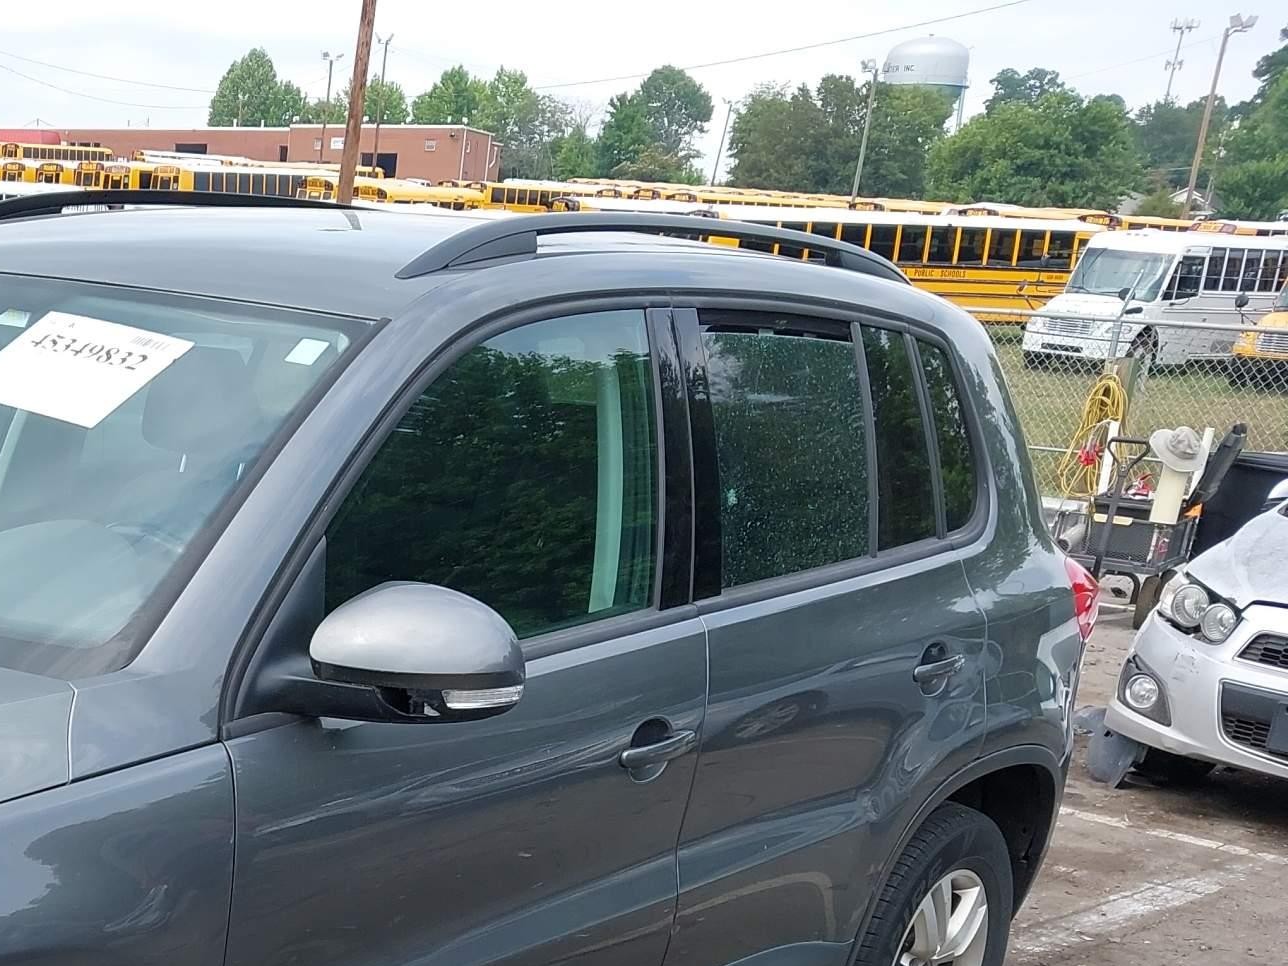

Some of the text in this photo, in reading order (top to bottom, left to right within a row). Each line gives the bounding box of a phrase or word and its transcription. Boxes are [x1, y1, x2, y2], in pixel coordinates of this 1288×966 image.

[914, 269, 934, 278] PUBLIC
[940, 270, 966, 278] SCHOOLS
[31, 333, 148, 370] 45349832
